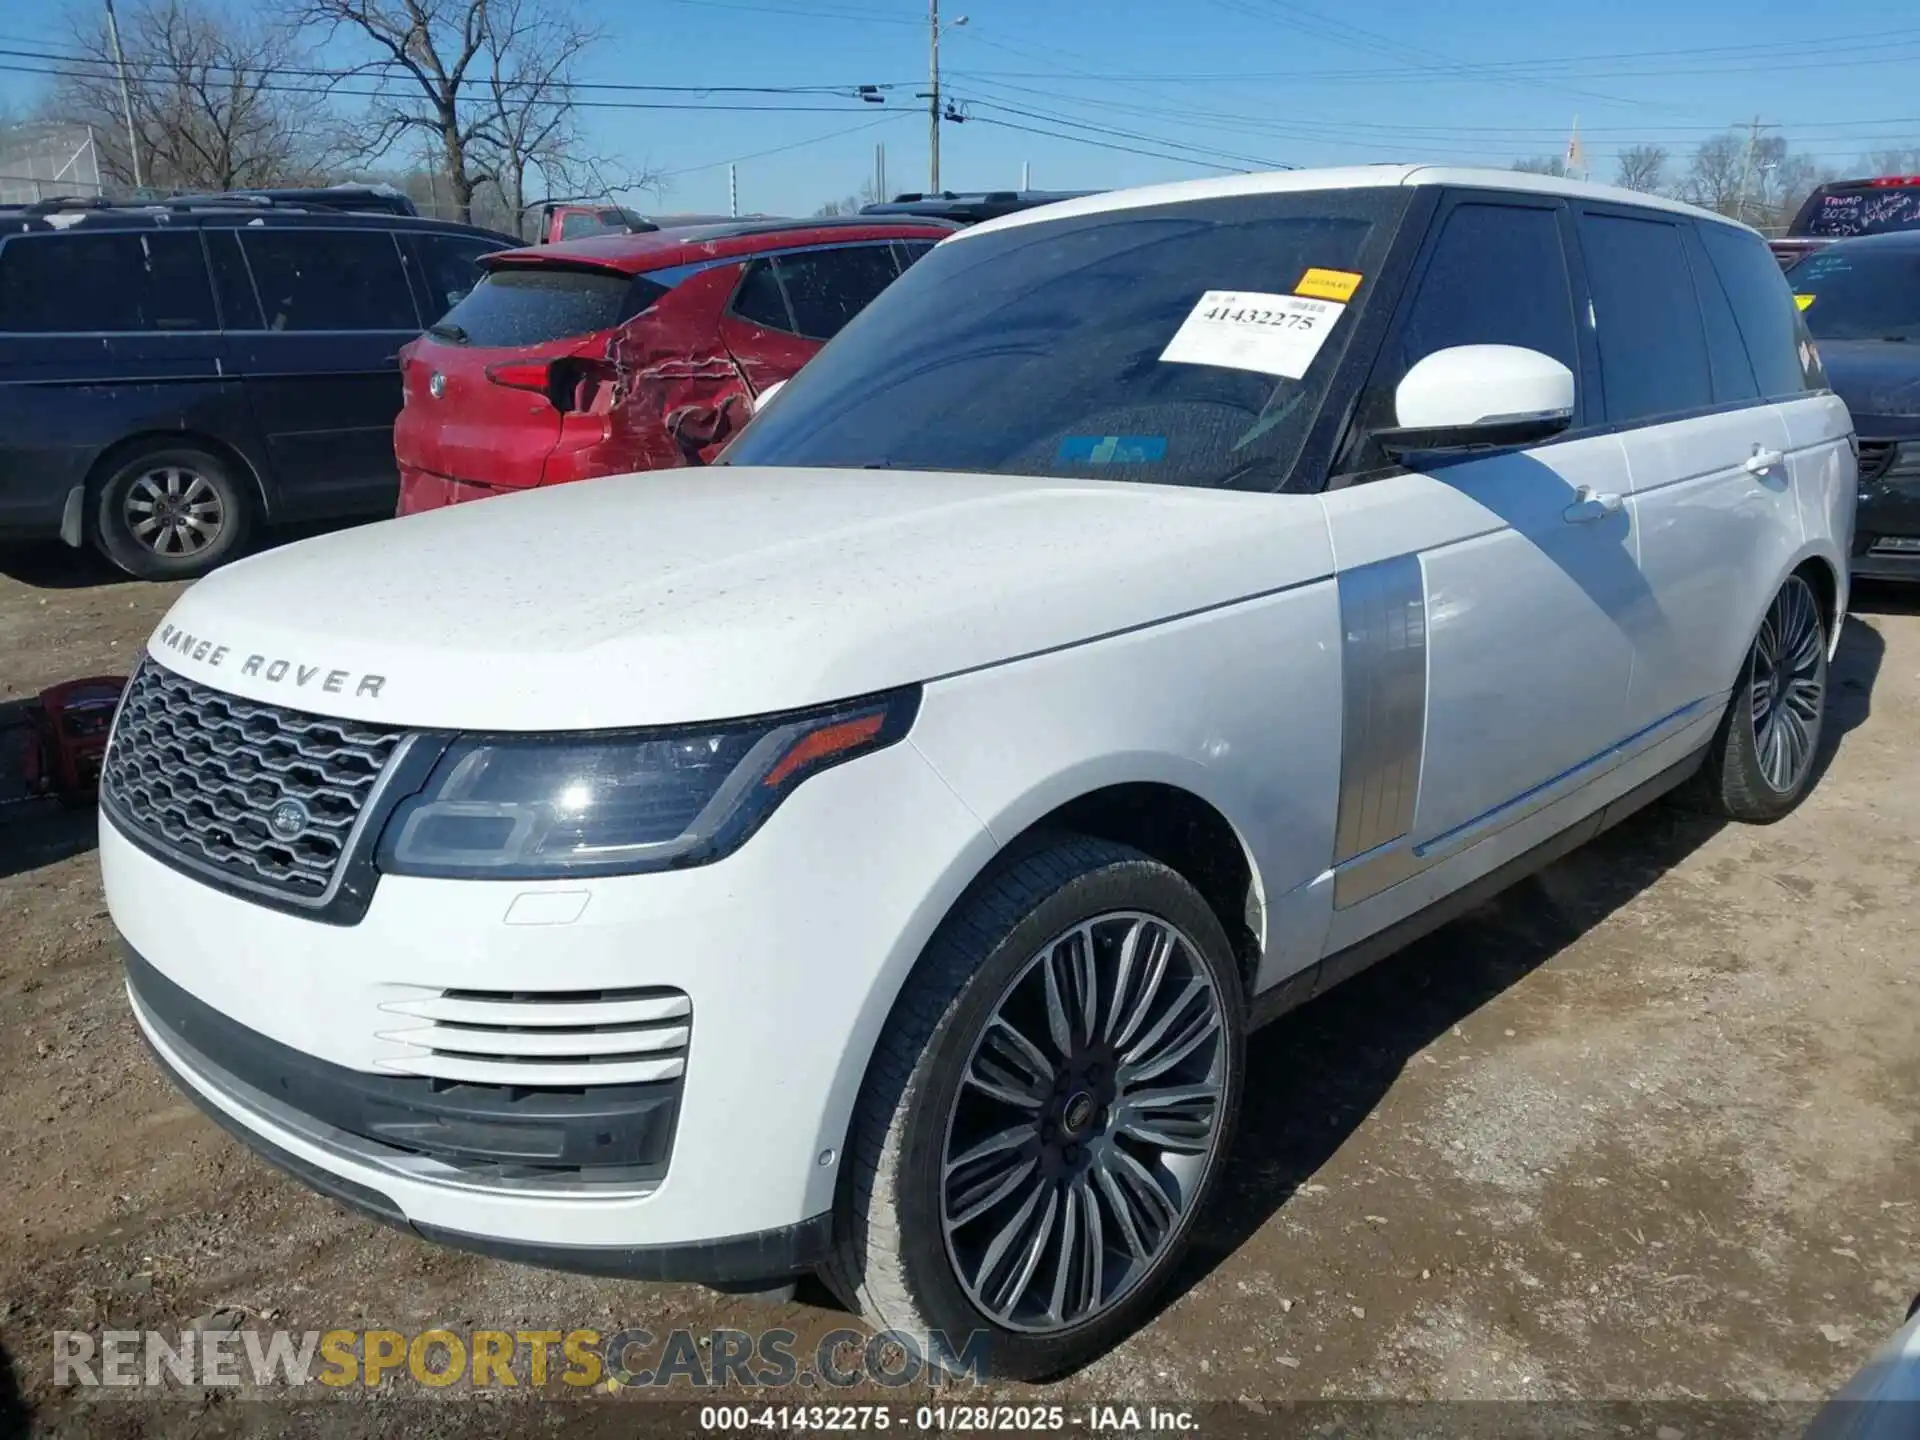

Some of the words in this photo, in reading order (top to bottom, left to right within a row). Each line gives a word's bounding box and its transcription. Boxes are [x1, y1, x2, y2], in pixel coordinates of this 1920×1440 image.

[1204, 306, 1316, 330] 41432275
[162, 623, 230, 666] RANGE
[241, 655, 386, 698] ROVER
